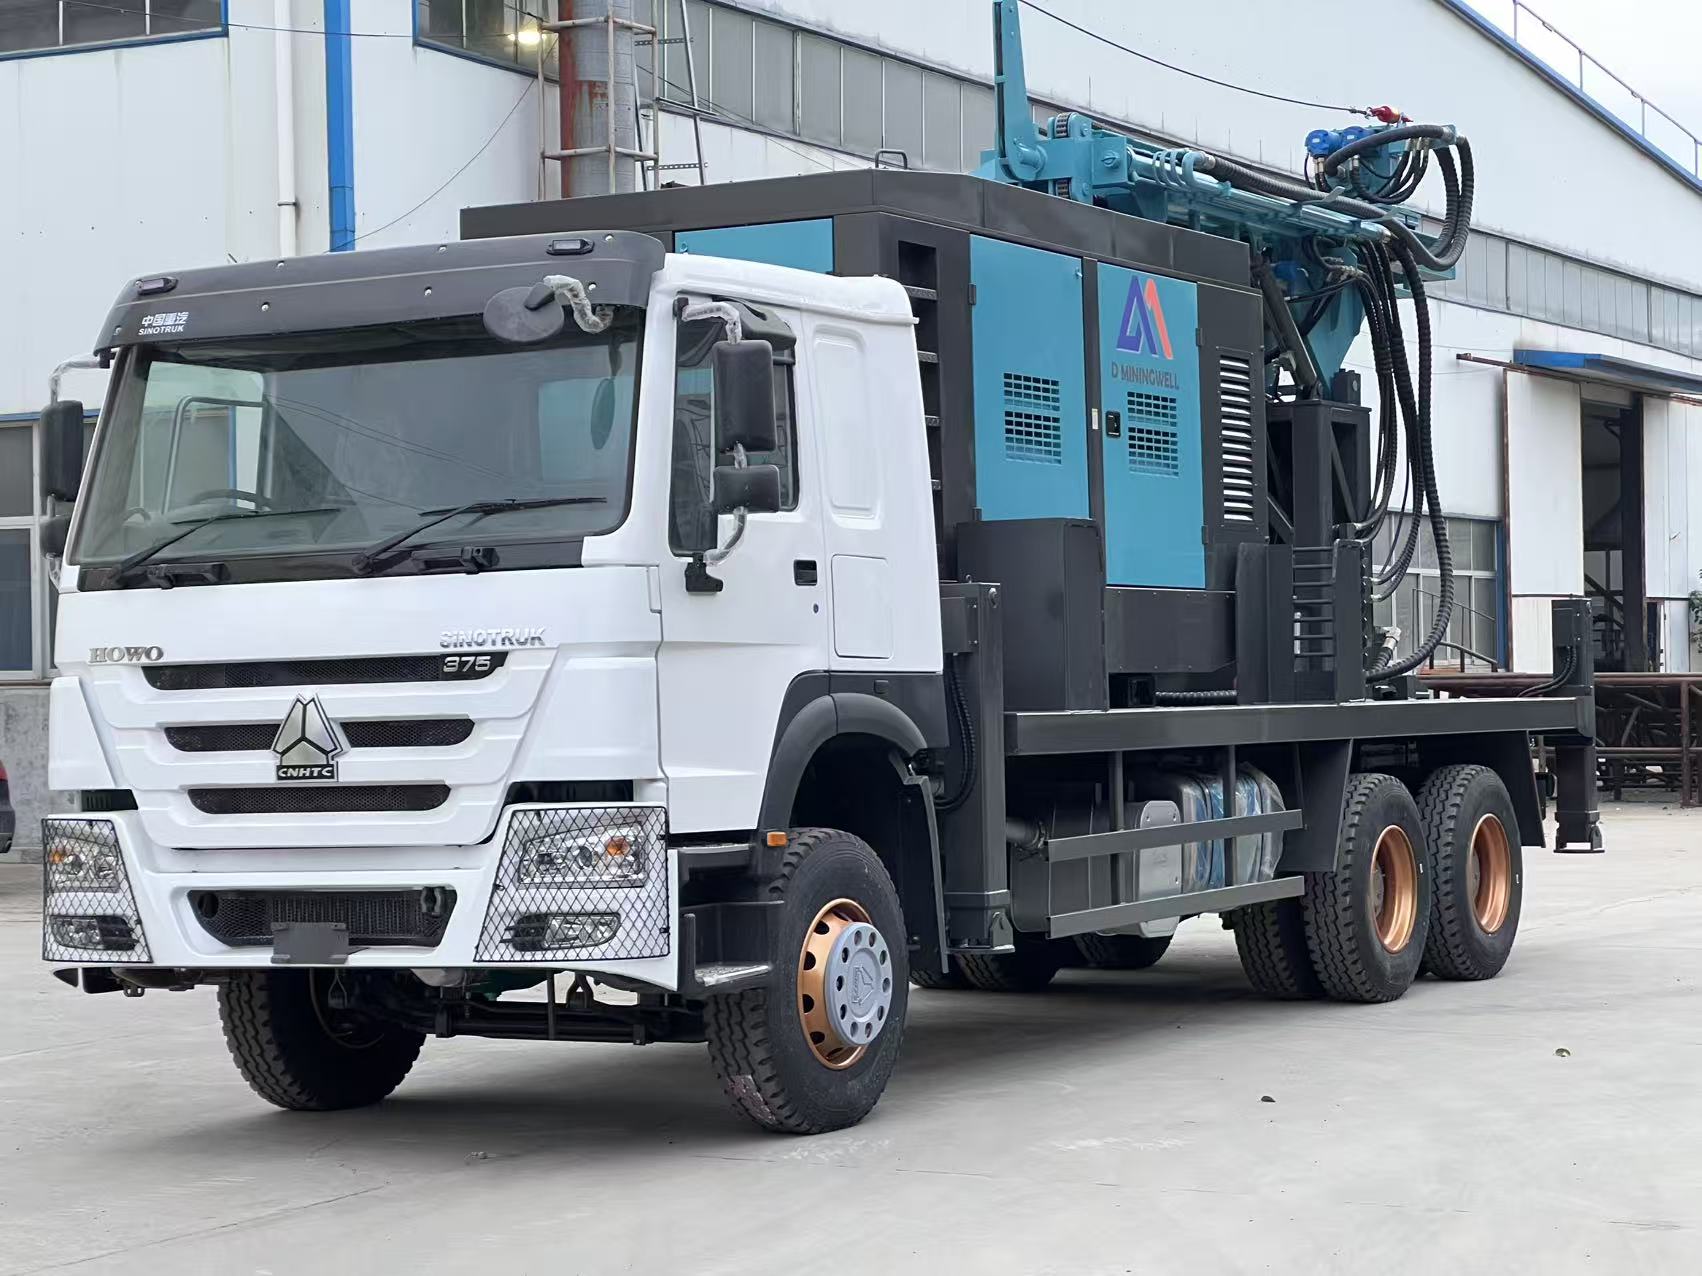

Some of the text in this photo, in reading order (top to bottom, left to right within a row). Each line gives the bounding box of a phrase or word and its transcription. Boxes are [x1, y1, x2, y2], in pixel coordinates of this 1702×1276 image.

[141, 312, 189, 327] 中国重汽
[138, 325, 184, 335] SINOTRUK
[1111, 362, 1180, 390] D MININGWELL
[440, 627, 546, 648] SINOTRUK
[88, 646, 164, 663] HOWO
[443, 656, 491, 672] 375
[278, 767, 333, 777] CNHTC
